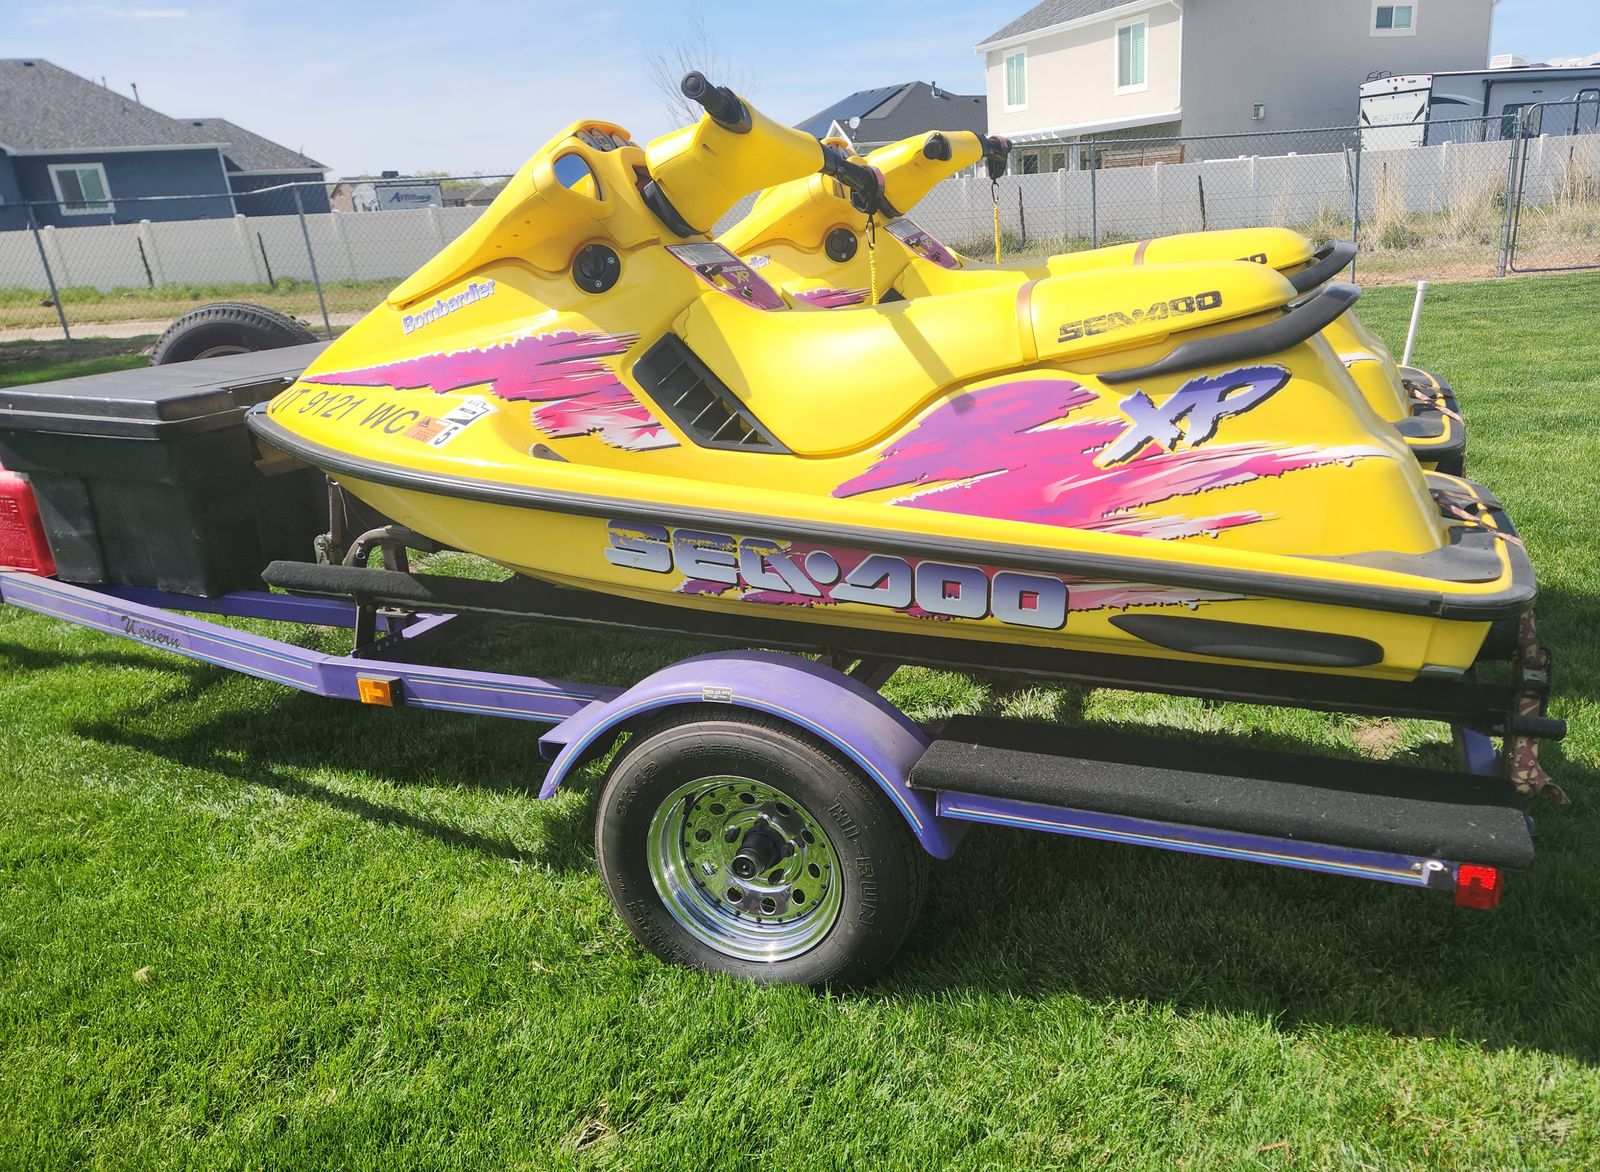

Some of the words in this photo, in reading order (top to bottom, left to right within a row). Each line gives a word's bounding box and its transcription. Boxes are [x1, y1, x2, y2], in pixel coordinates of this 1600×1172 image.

[402, 280, 496, 335] Bombardier
[271, 389, 312, 415] UT
[298, 391, 367, 420] 9121
[359, 402, 421, 434] WC
[1093, 363, 1293, 469] XP
[120, 615, 181, 648] Western
